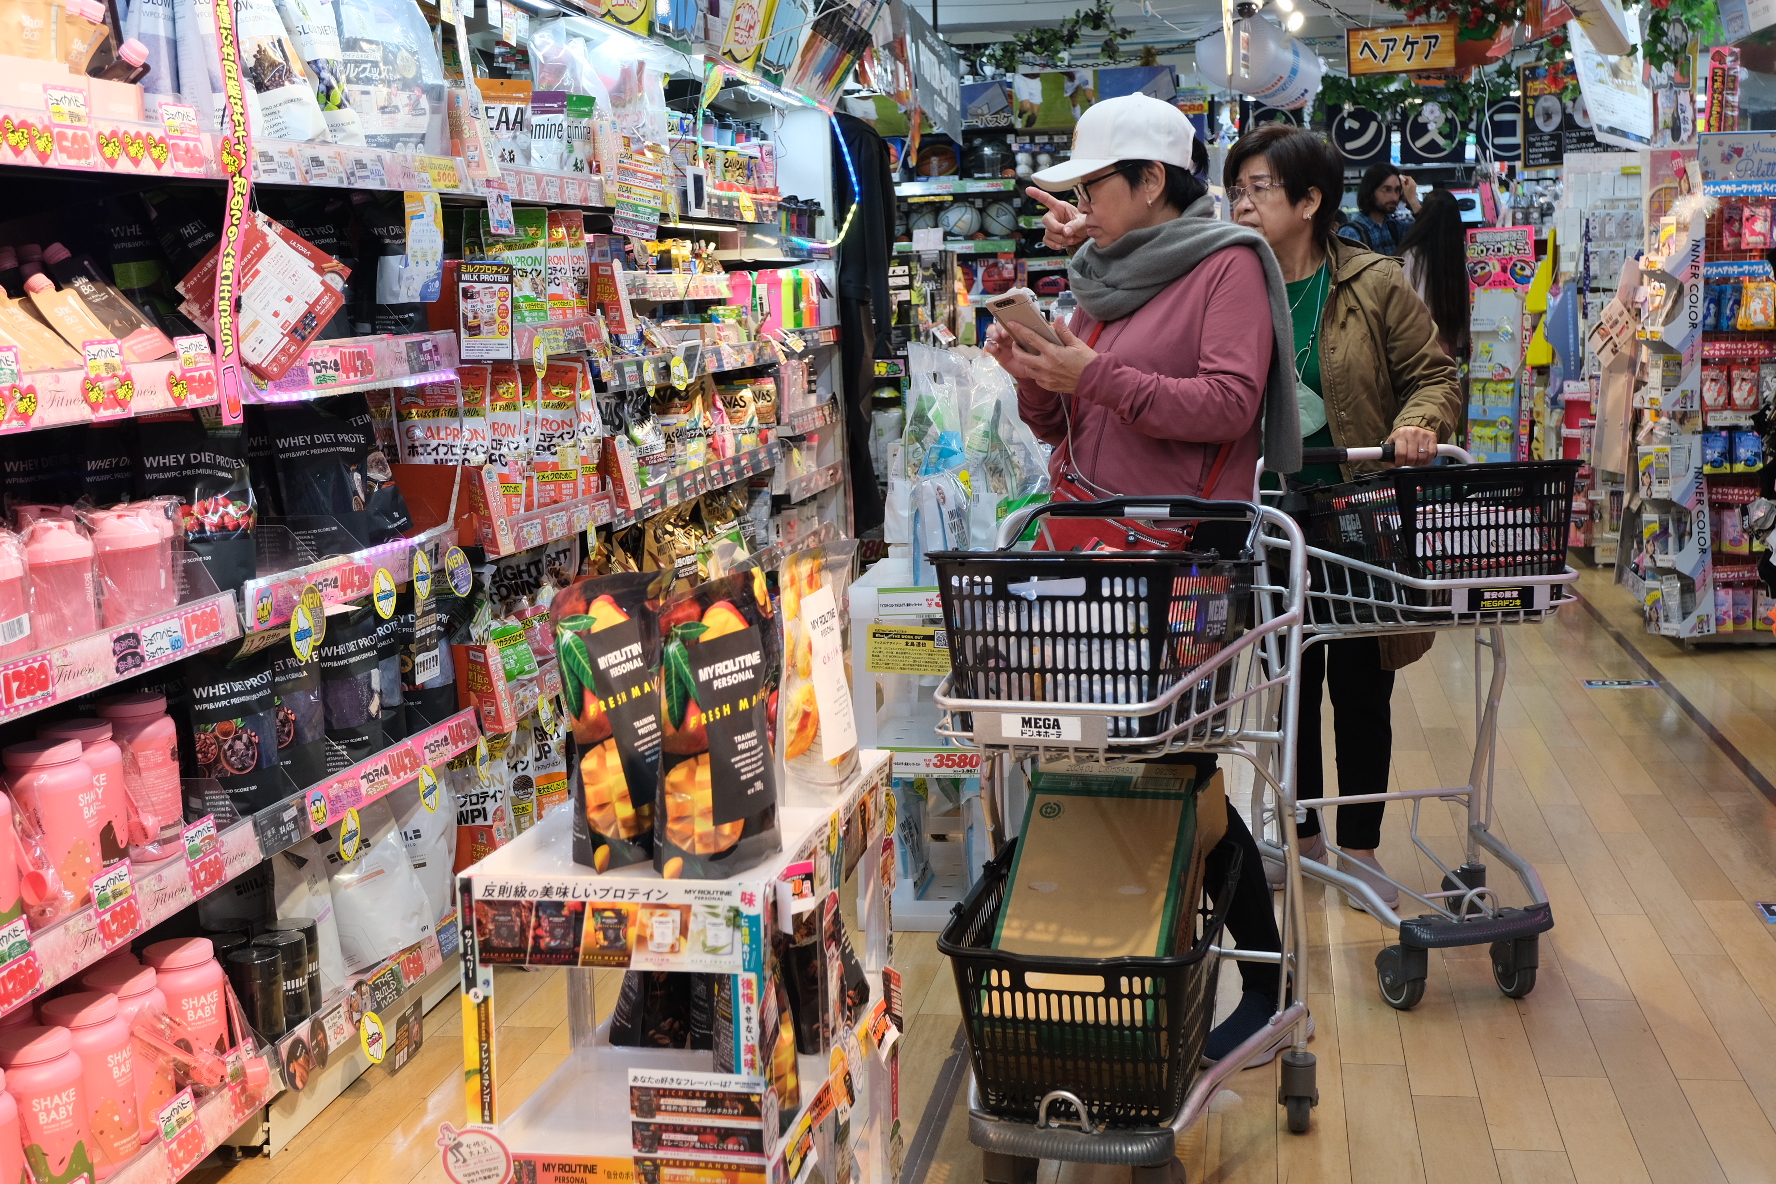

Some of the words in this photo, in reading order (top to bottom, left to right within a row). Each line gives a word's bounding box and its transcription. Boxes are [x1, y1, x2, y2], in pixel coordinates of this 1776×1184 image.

[1357, 33, 1442, 65] ヘアケア
[484, 105, 524, 133] EAA
[1690, 239, 1701, 279] INNER
[460, 264, 510, 274] ミルクプロテイン
[461, 273, 479, 281] MILK
[480, 274, 510, 283] PROTEIN
[1688, 282, 1700, 329] COLOR
[276, 434, 311, 449] WHEY
[313, 433, 336, 444] DIET
[424, 425, 487, 442] ALPRON
[86, 457, 118, 471] WHEY
[143, 453, 186, 468] WHEY
[189, 452, 214, 464] DIET
[279, 450, 311, 460] WPI&WPC
[144, 470, 182, 480] WPI&WPC
[183, 468, 213, 477] PREMIUM
[1693, 466, 1706, 507] INNER
[1338, 513, 1362, 532] MEGA
[1696, 508, 1707, 556] COLOR
[447, 553, 465, 570] NEW
[302, 593, 321, 609] NEW
[1480, 600, 1522, 608] MEGAドンキ
[53, 661, 96, 685] Fitness
[610, 656, 644, 679] PERSONAL
[712, 668, 755, 690] PERSONAL
[193, 682, 232, 699] WHEY
[194, 698, 231, 711] WPI&WPC
[589, 691, 628, 717] FRESH
[689, 703, 731, 729] FRESH
[1021, 716, 1062, 730] MEGA
[733, 729, 758, 744] TRAINING
[737, 738, 759, 751] PROTEIN
[932, 754, 981, 769] 3580
[456, 807, 489, 827] WPI
[147, 883, 188, 912] Fitness
[482, 881, 670, 903] 反則級の美味しいプロテイン
[697, 888, 734, 897] ROUTINE
[740, 891, 757, 909] 味
[464, 929, 474, 979] サワーベリー
[375, 969, 394, 987] THE
[181, 990, 219, 1011] SHAKE
[374, 981, 398, 1002] BUILD
[473, 992, 480, 1001] &
[186, 1002, 217, 1023] BABY
[631, 1074, 733, 1090] あなたの好きなフレーバーは?
[32, 1087, 77, 1113] SHAKE
[38, 1101, 75, 1126] BABY
[542, 1162, 558, 1173] MY
[561, 1163, 598, 1175] ROUTINE
